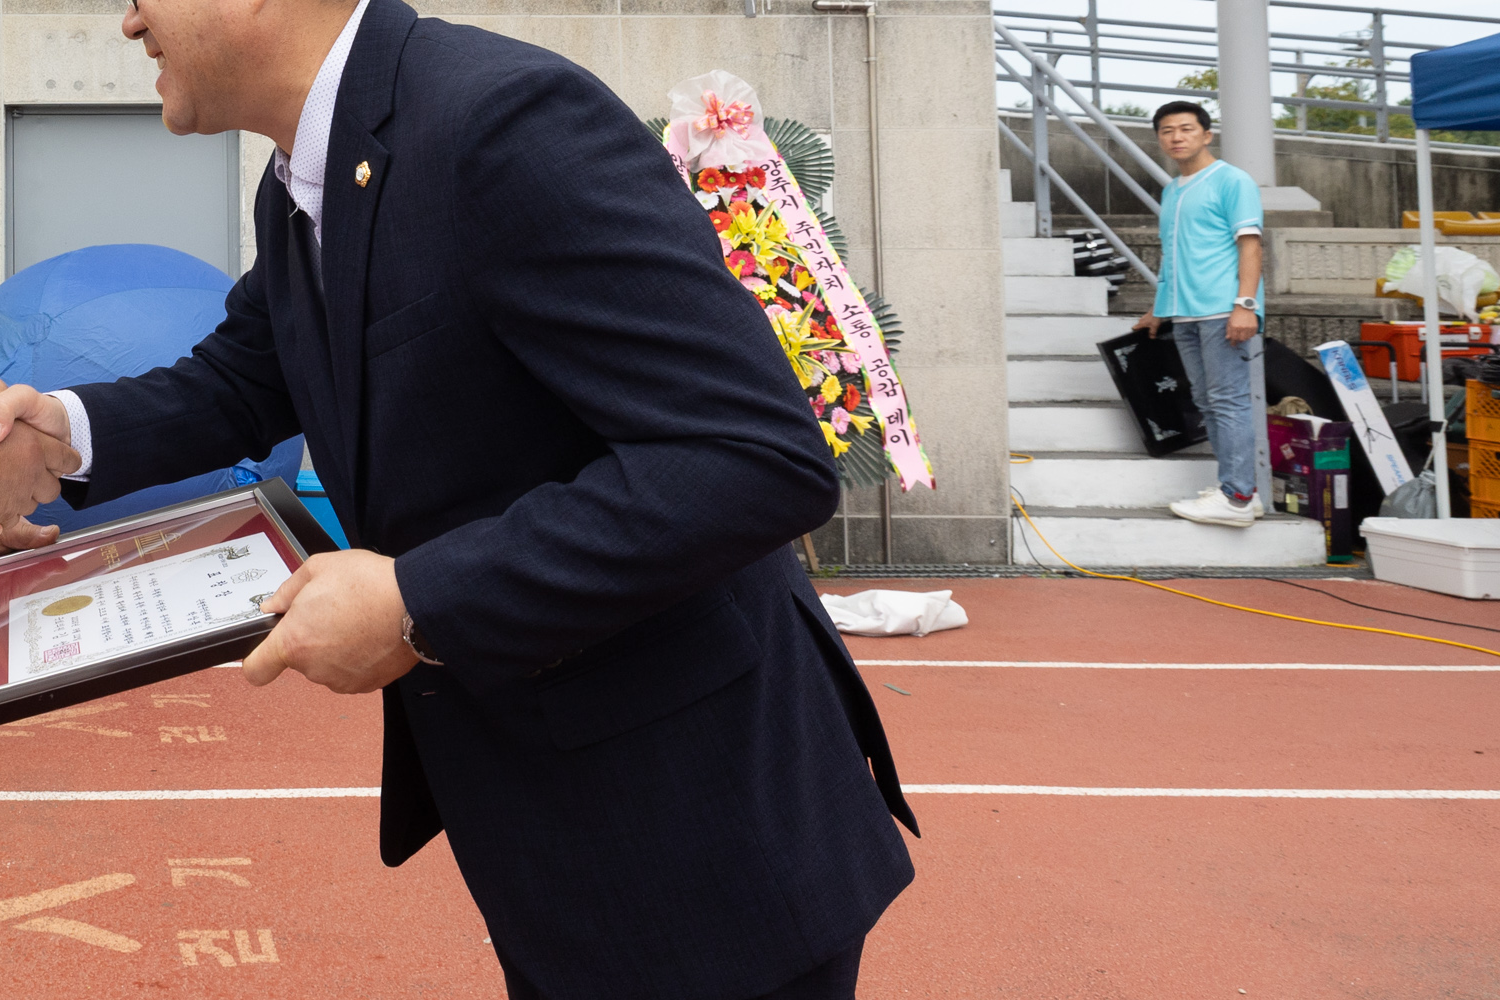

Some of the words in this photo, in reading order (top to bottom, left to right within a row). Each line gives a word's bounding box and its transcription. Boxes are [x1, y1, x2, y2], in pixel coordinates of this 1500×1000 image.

[760, 159, 800, 210] 양주시
[794, 220, 844, 290] 주민자치
[841, 303, 873, 339] 소통
[870, 358, 899, 398] 공감
[886, 408, 910, 446] 데이
